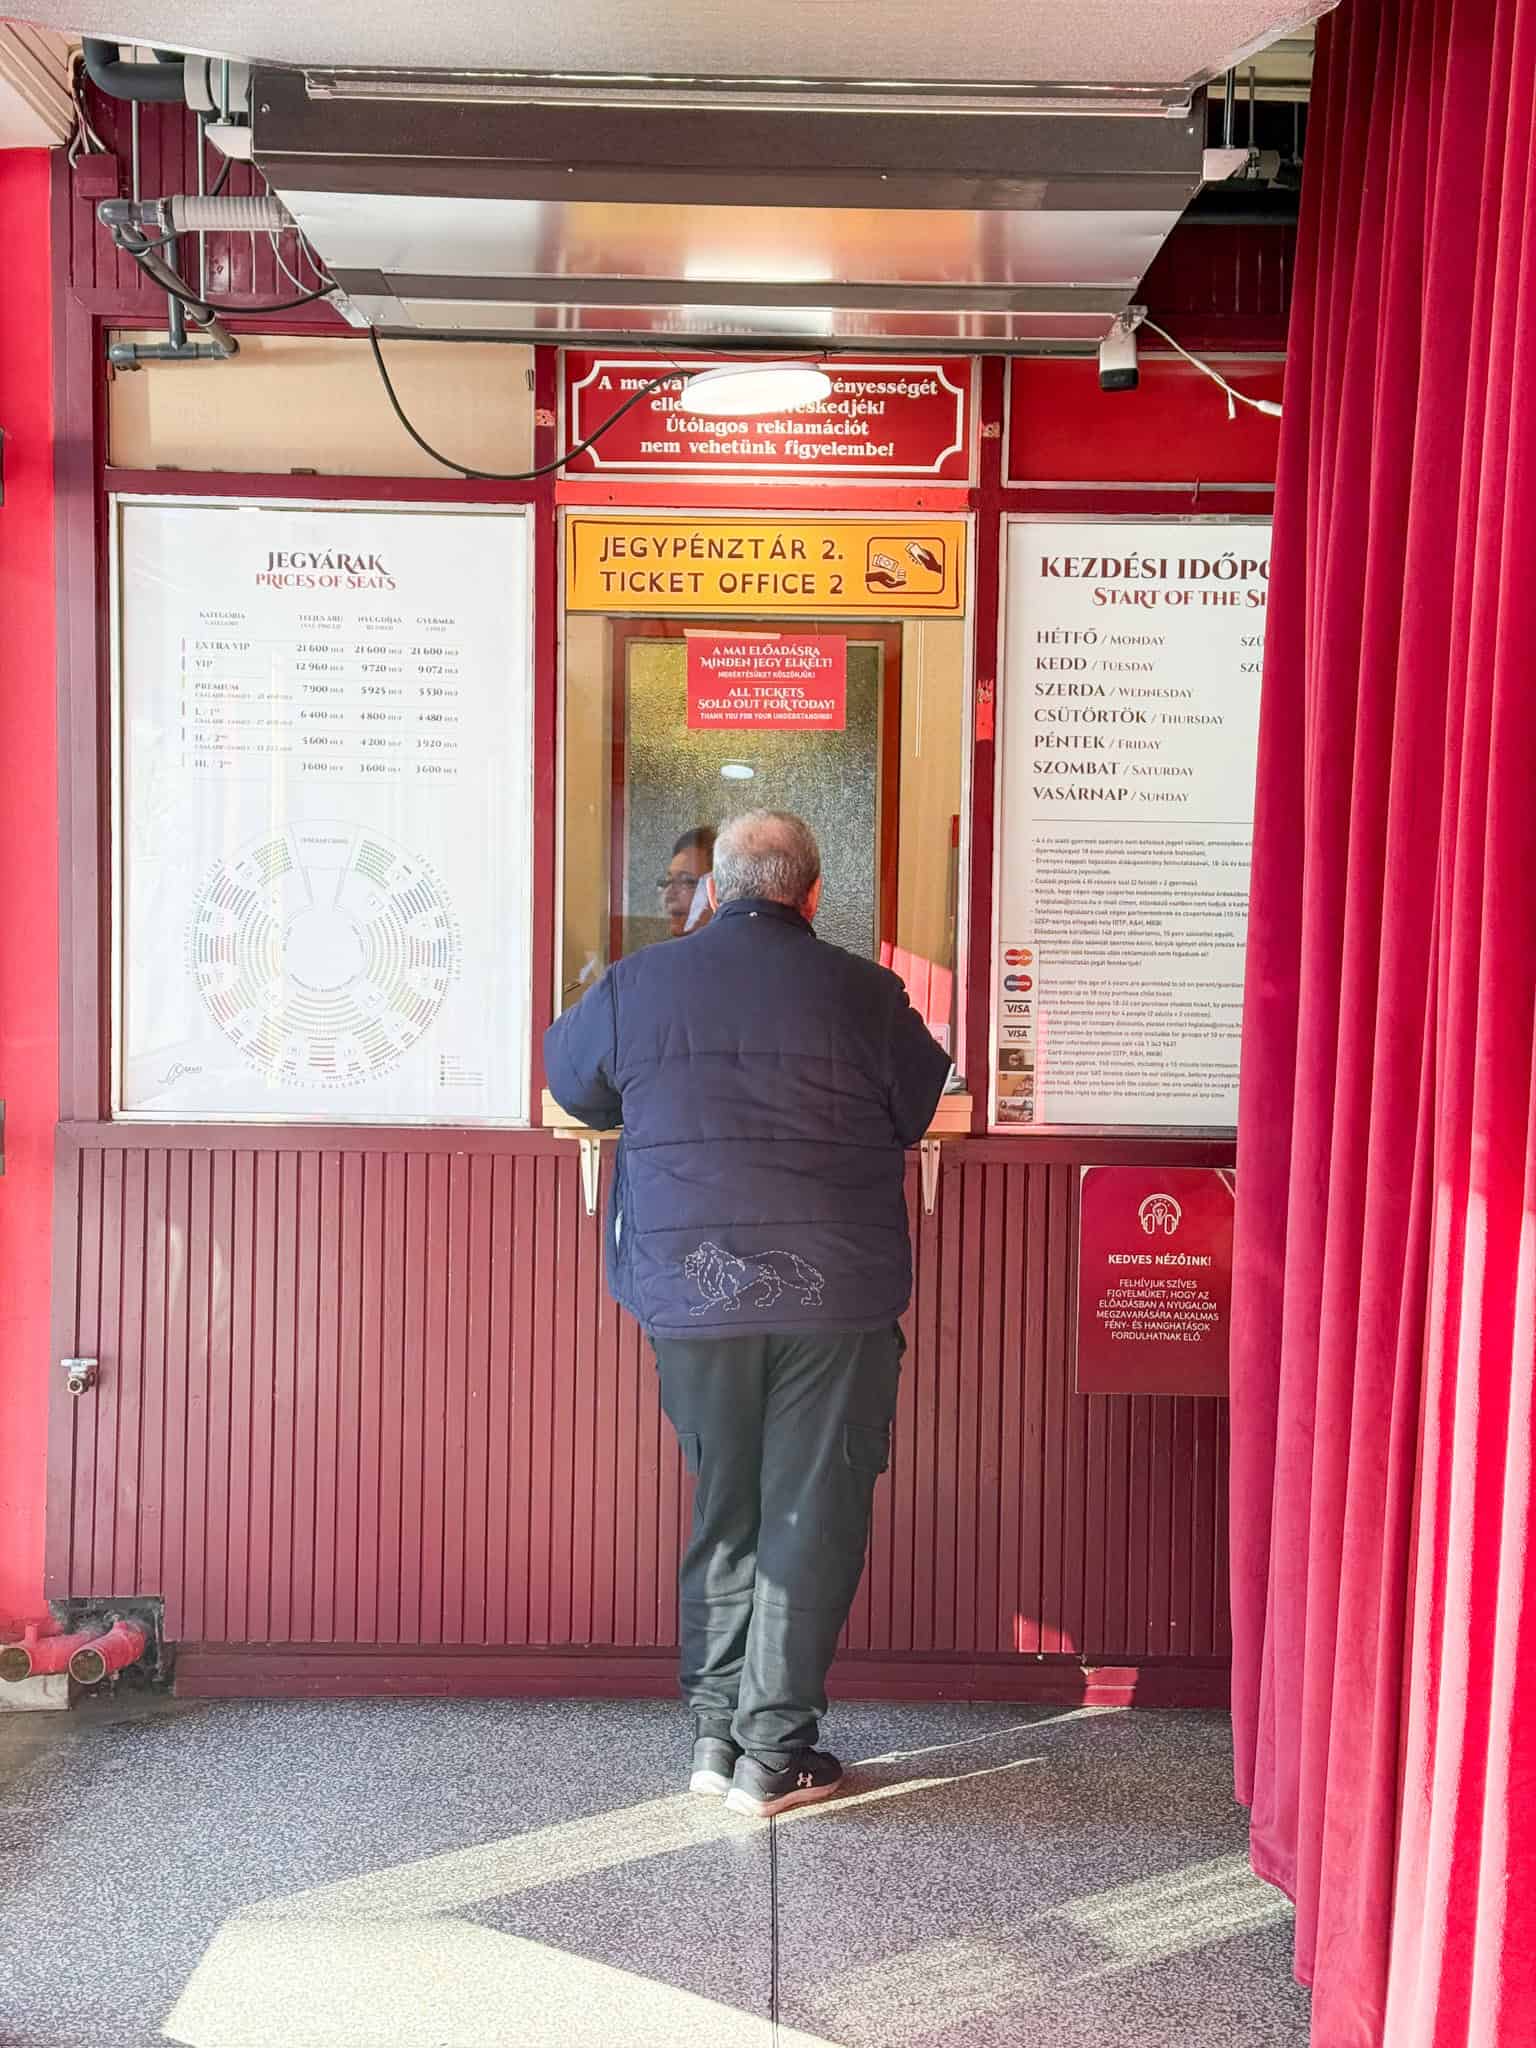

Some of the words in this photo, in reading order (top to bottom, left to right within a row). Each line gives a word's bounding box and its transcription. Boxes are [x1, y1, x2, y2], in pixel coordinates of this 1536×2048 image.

[597, 375, 612, 391] A
[665, 413, 749, 436] Útólagos
[755, 418, 870, 436] reklamációt
[640, 441, 681, 454] nem
[688, 439, 777, 455] vehetünk
[784, 439, 894, 459] figyelembe!
[599, 533, 808, 562] JEGYPÉNZTÁR
[822, 539, 844, 560] 2.
[266, 548, 391, 575] JEGYÁRAK
[1041, 552, 1169, 579] KEZDÉSI
[256, 574, 316, 590] PRICES
[319, 574, 342, 587] OF
[346, 575, 397, 591] SEATS
[599, 571, 705, 593] TICKET
[719, 572, 817, 594] OFFICE
[829, 574, 843, 594] 2
[1092, 586, 1161, 609] START
[1165, 590, 1195, 606] OF
[1199, 590, 1242, 606] THE
[1036, 626, 1098, 645] HÉTFŐ
[1110, 634, 1166, 646] MONDAY
[231, 641, 250, 650] VIP
[308, 644, 328, 653] 600
[366, 645, 386, 654] 600
[422, 648, 442, 656] 600
[712, 646, 721, 656] A
[723, 646, 746, 656] MAI
[749, 643, 821, 657] ELŐADÁSRA
[195, 659, 213, 668] VIP
[699, 656, 751, 669] MINDEN
[753, 657, 782, 669] JEGY
[784, 657, 833, 670] ELKELT!
[1036, 656, 1088, 671] KEDD
[1102, 660, 1155, 672] TUESDAY
[728, 688, 751, 697] ALL
[753, 687, 805, 699] TICKETS
[1034, 682, 1106, 697] SZERDA
[1118, 686, 1195, 699] WEDNESDAY
[697, 698, 731, 710] SOLD
[733, 699, 760, 710] OUT
[763, 699, 793, 712] FOR
[793, 699, 835, 710] TODAY!
[1034, 706, 1147, 723] CSÜTÖRTÖK
[1160, 712, 1225, 725] THURSDAY
[1034, 731, 1105, 749] PÉNTEK
[1118, 738, 1162, 750] FRIDAY
[1032, 760, 1121, 775] SZOMBAT
[1131, 764, 1195, 777] SATURDAY
[1032, 783, 1128, 801] VASÁRNAP
[1139, 791, 1191, 803] SUNDAY
[1006, 1004, 1030, 1013] VISA
[1007, 1030, 1027, 1038] VISA
[1108, 1254, 1152, 1265] KEDVES
[1155, 1253, 1212, 1267] NÉZŐINK!
[1119, 1277, 1166, 1288] FELHÍVJUK
[1167, 1278, 1198, 1289] SZÍVES
[1170, 1291, 1196, 1300] HOGY
[1197, 1291, 1209, 1300] AZ
[1098, 1299, 1157, 1309] ELŐADÁSBAN
[1158, 1301, 1165, 1309] A
[1166, 1301, 1217, 1311] NYUGALOM
[1096, 1309, 1174, 1319] MEGZAVARÁSÁRA
[1174, 1311, 1219, 1321] ALKALMAS
[1104, 1319, 1130, 1329] FÉNY-
[1131, 1319, 1143, 1329] ÉS
[1144, 1320, 1210, 1331] HANGHATÁSOK
[1111, 1330, 1182, 1341] FORDULHATNAK
